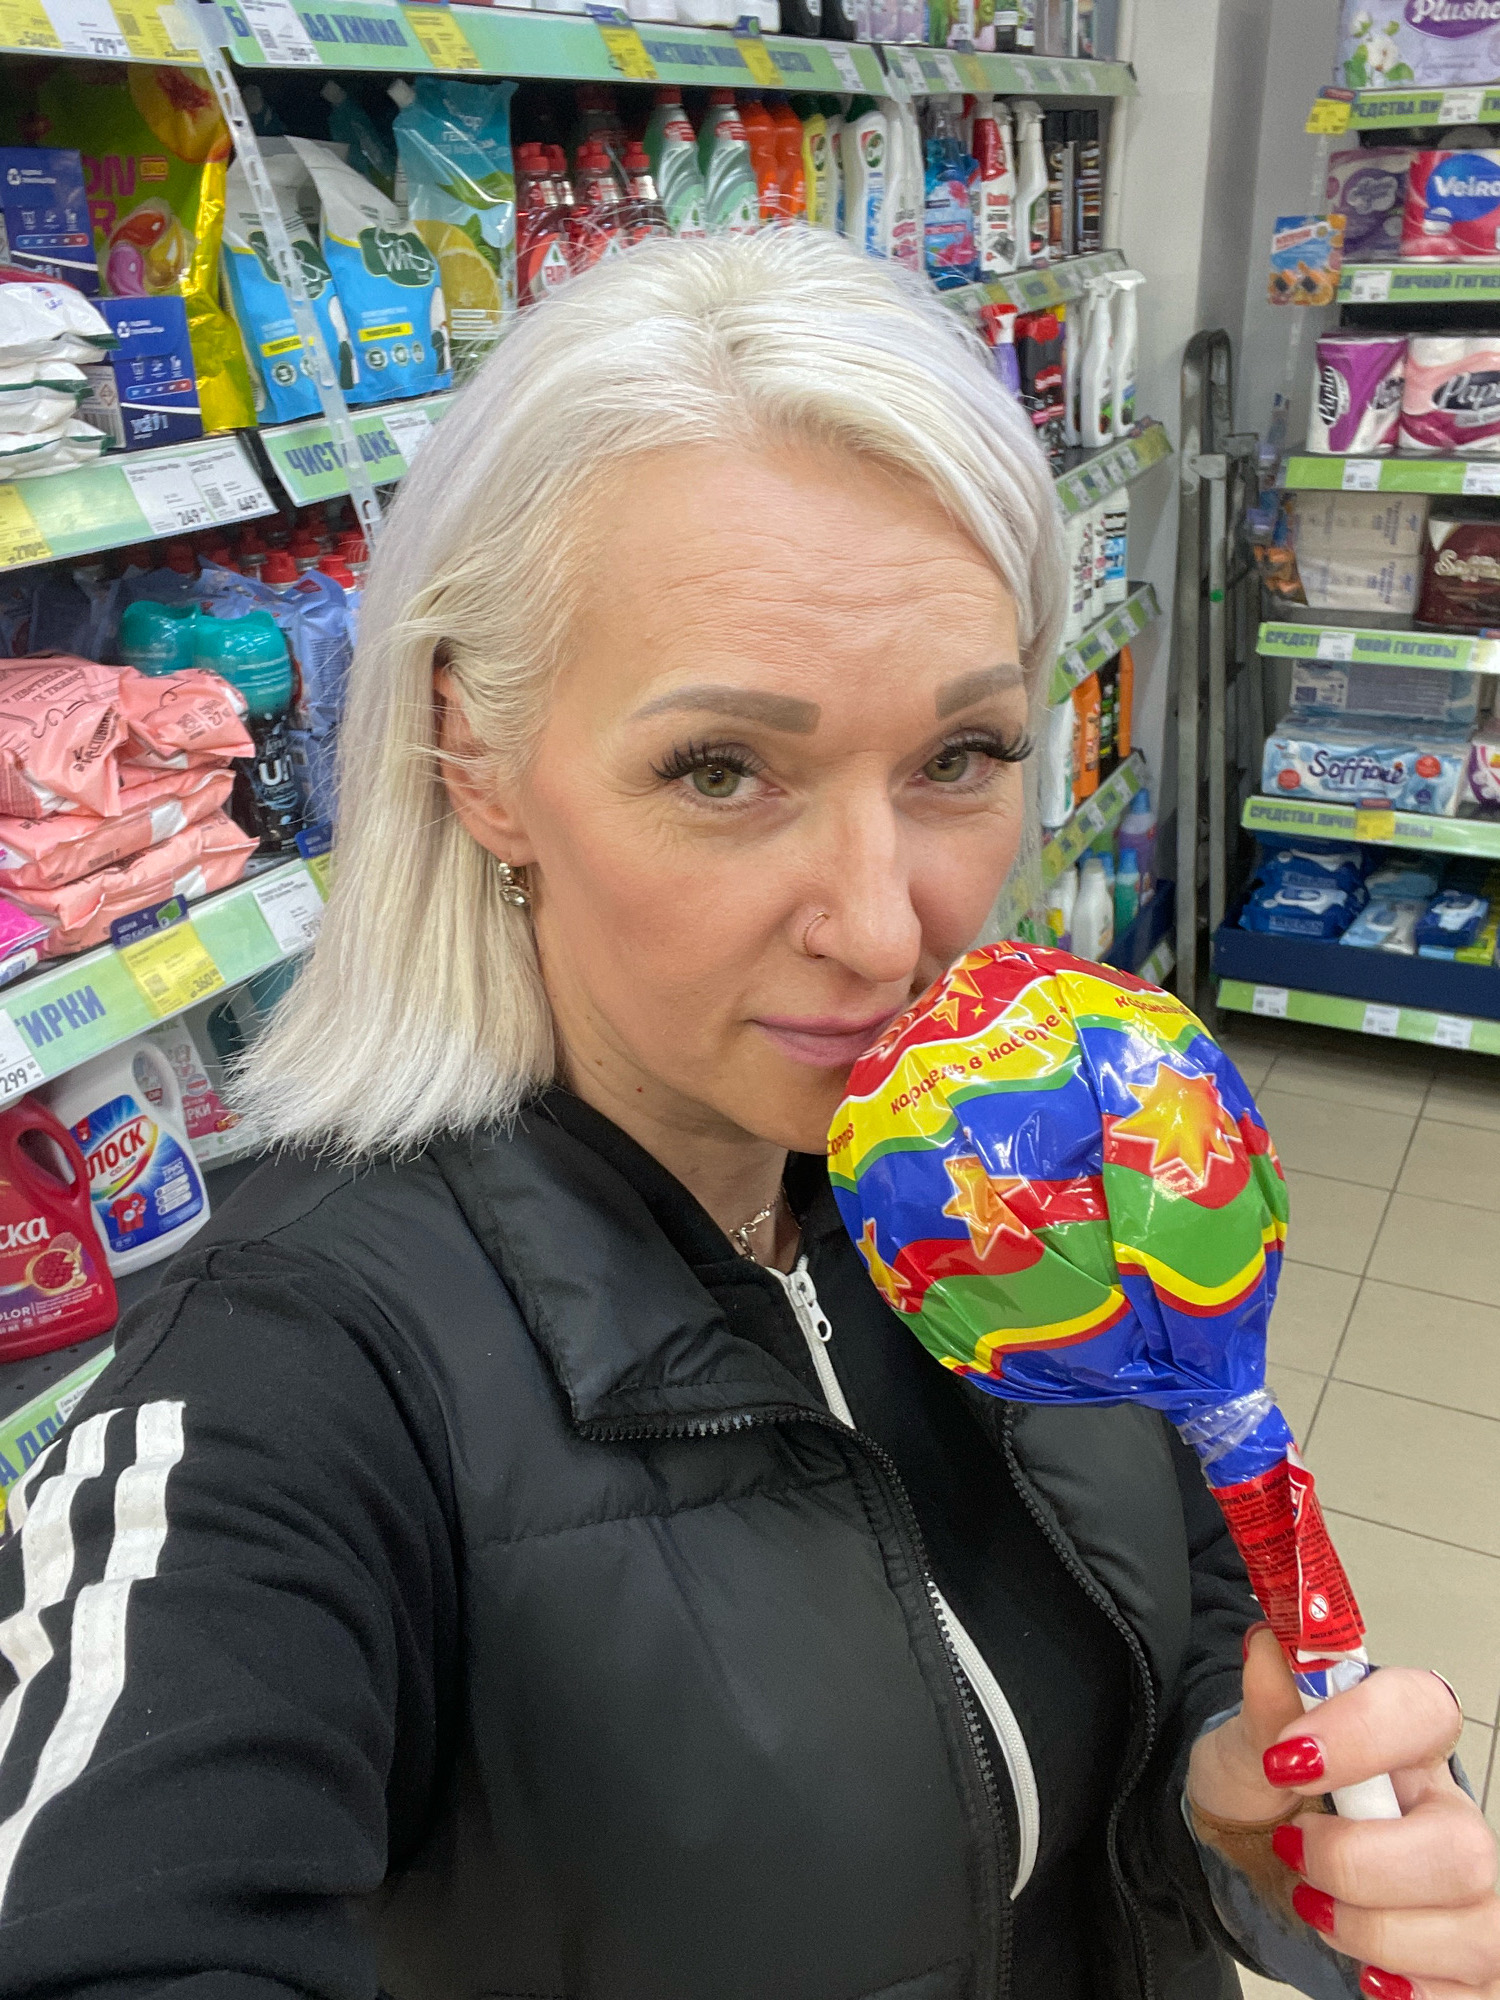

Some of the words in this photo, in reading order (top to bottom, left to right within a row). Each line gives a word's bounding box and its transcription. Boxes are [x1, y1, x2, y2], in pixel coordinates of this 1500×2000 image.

[1437, 371, 1500, 411] Pap
[284, 429, 400, 477] ЧИСТЩИЕ
[15, 985, 106, 1048] ИРКИ
[969, 1055, 983, 1070] в
[987, 1013, 1062, 1062] наборе
[86, 1121, 147, 1182] ЛОСК
